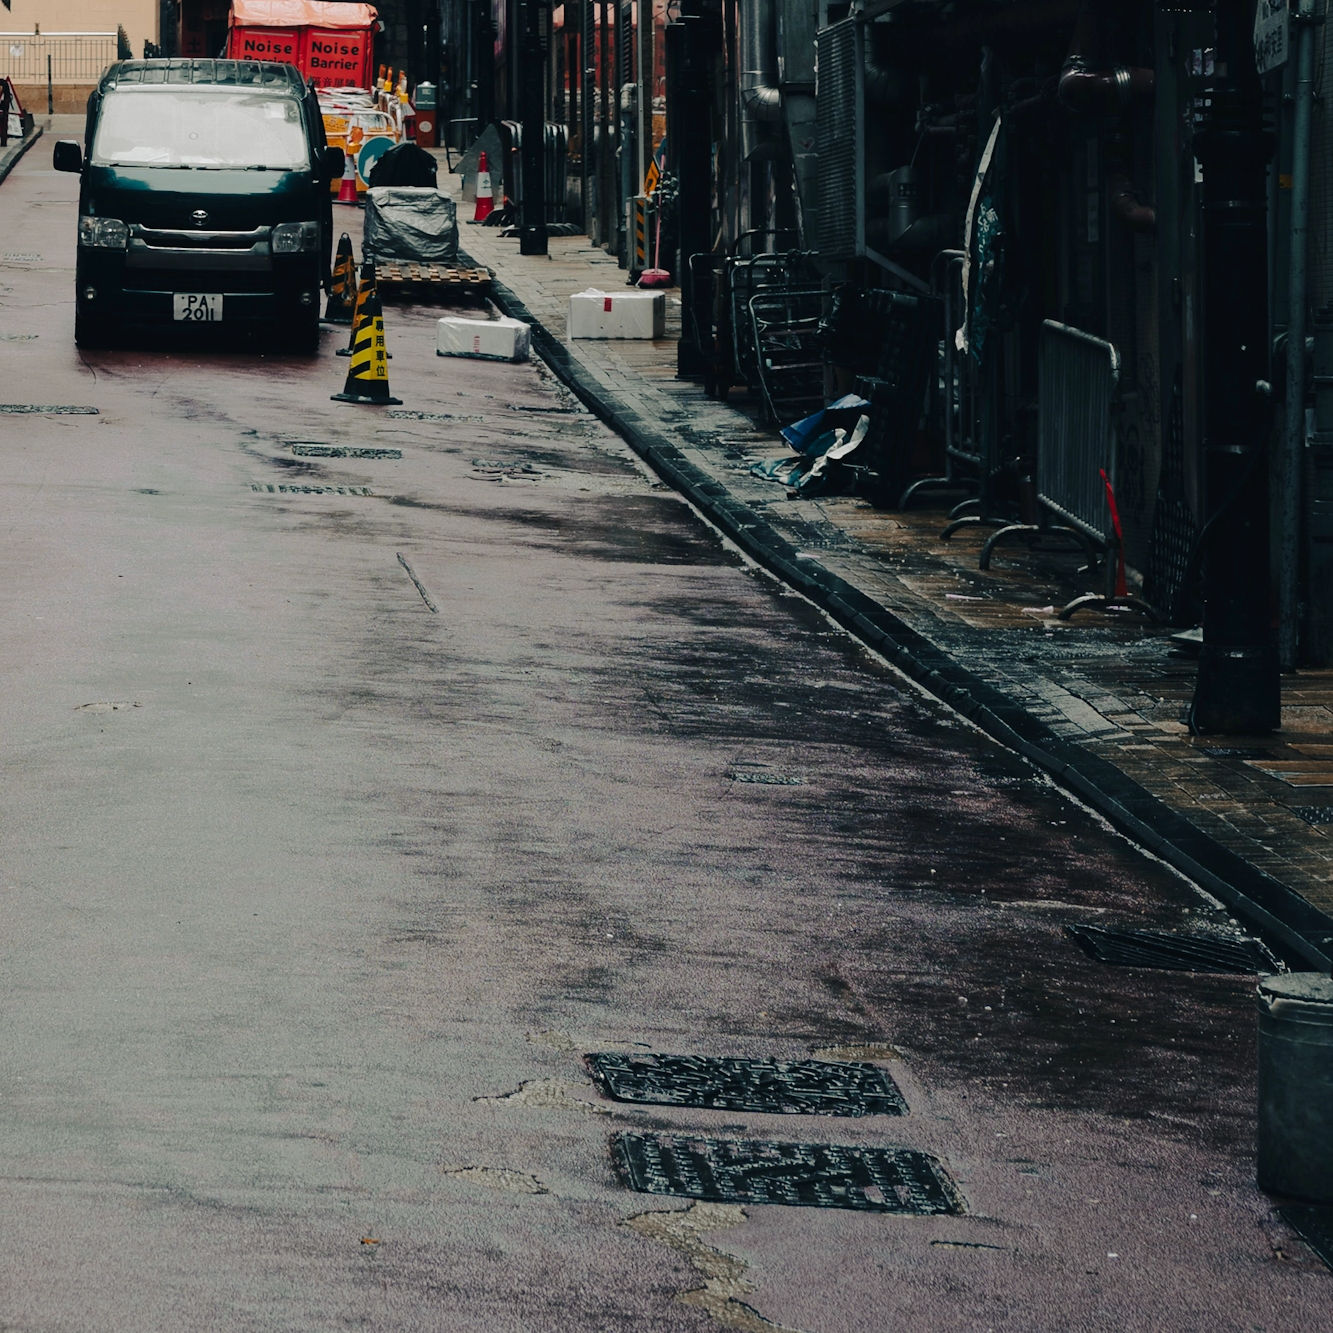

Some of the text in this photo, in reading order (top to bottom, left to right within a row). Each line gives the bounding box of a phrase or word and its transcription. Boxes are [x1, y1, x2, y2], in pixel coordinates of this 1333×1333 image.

[244, 39, 293, 54] Noise
[311, 41, 360, 56] Noise
[311, 57, 358, 70] Barrier
[188, 295, 208, 308] PA
[182, 307, 214, 321] 2011
